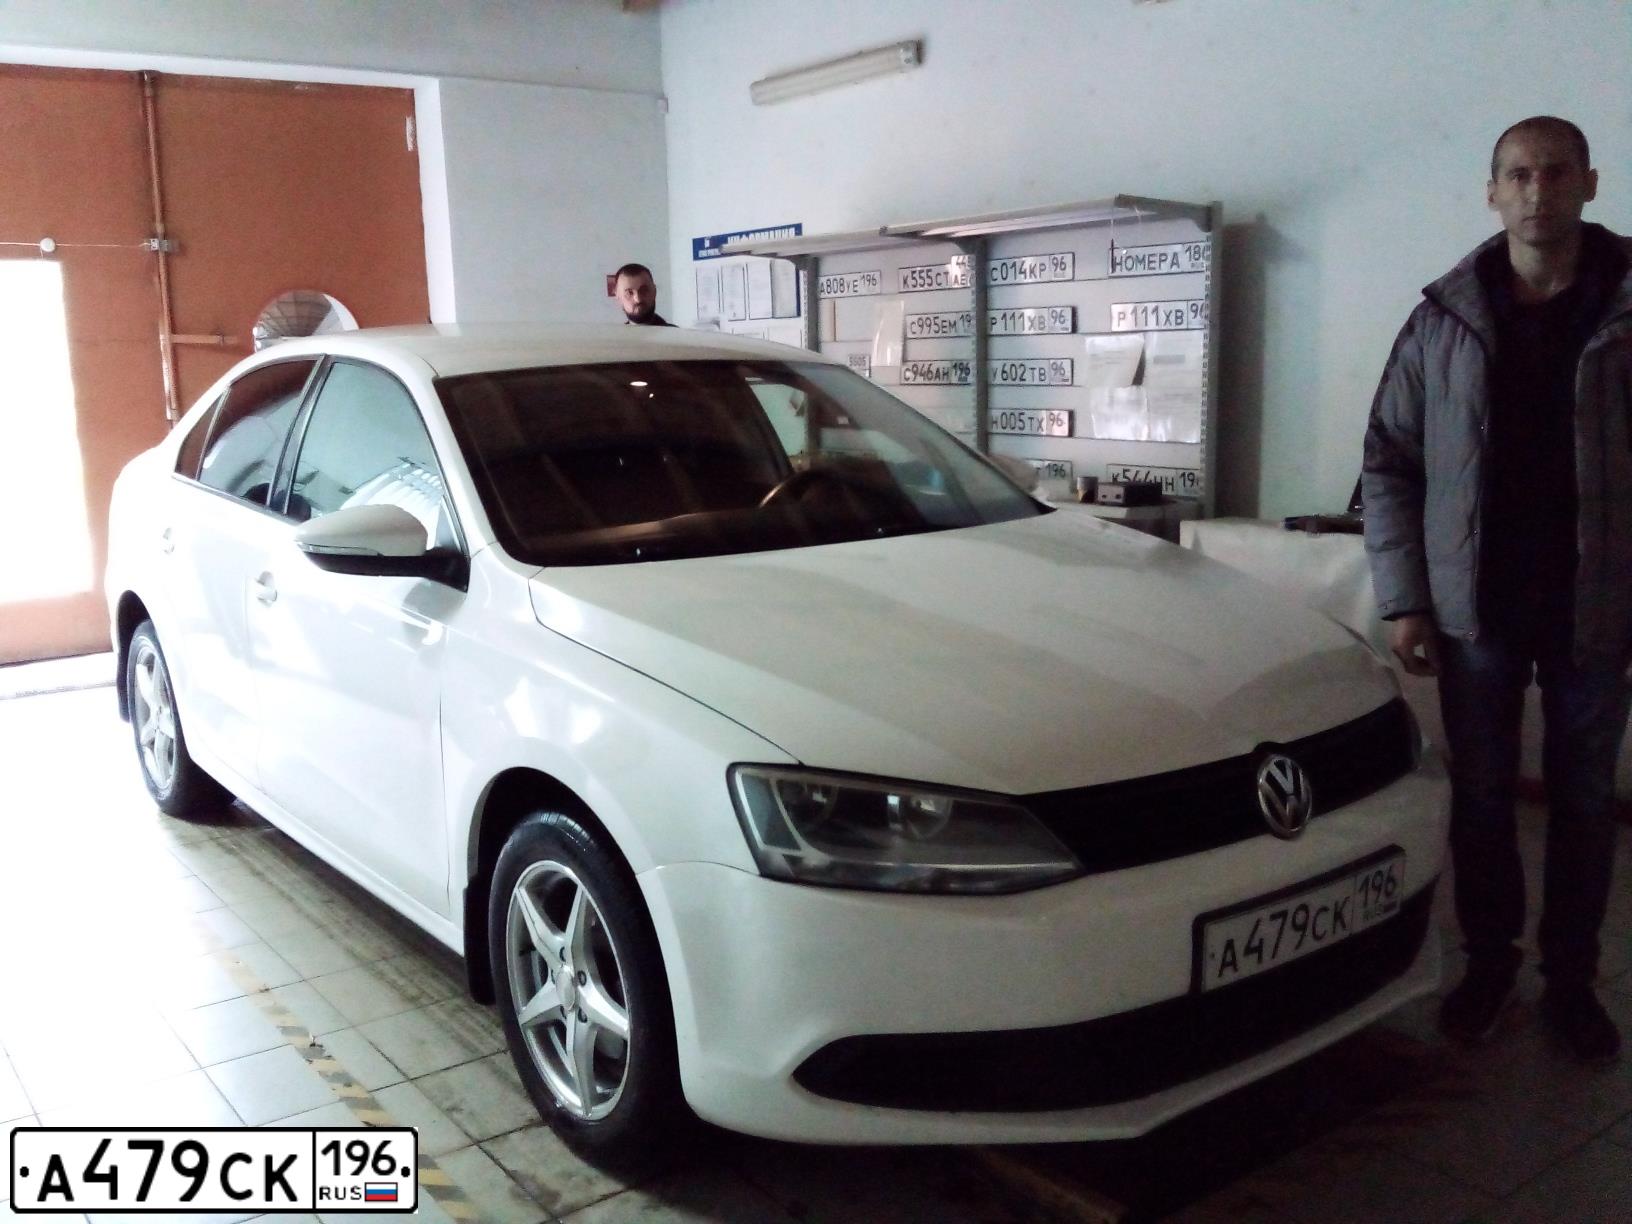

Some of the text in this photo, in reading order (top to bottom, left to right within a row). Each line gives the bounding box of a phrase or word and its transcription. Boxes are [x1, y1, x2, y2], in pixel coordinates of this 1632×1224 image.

[991, 256, 1067, 281] С014КР 96
[1114, 252, 1180, 273] НОМЕРА
[820, 277, 858, 295] А808УЕ
[902, 268, 950, 289] К555СТ
[910, 316, 957, 335] С995ЕМ
[989, 309, 1067, 332] Р111ХВ 96
[1117, 305, 1184, 328] Р111ХВ
[903, 361, 971, 382] С946АН 196
[991, 362, 1066, 382] У602ТВ 96
[991, 412, 1064, 432] Н005ТХ 96
[1180, 471, 1200, 488] 19
[1217, 865, 1398, 978] А479СК 196
